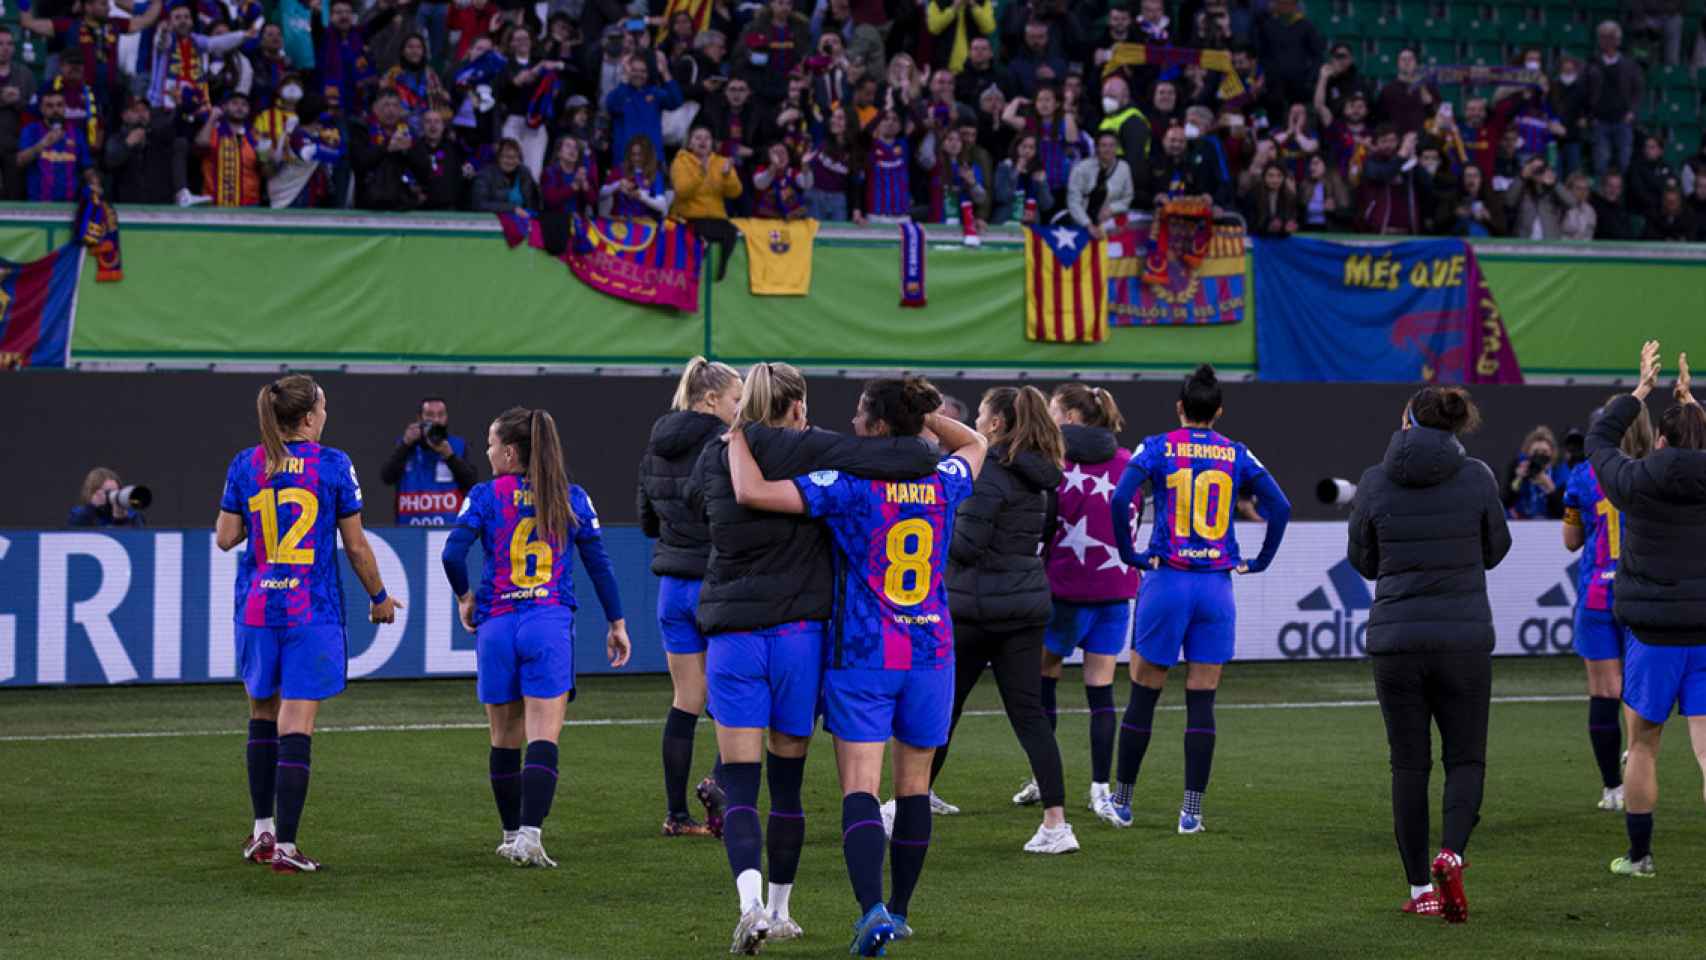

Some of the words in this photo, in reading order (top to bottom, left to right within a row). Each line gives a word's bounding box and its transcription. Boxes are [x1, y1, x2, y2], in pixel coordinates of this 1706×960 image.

[1177, 443, 1236, 462] HERMOSO
[248, 487, 319, 565] 12
[399, 493, 457, 512] PHOTO
[886, 482, 936, 504] MARTA
[1166, 468, 1233, 540] 10
[510, 517, 553, 588] 6
[884, 517, 934, 607] 8
